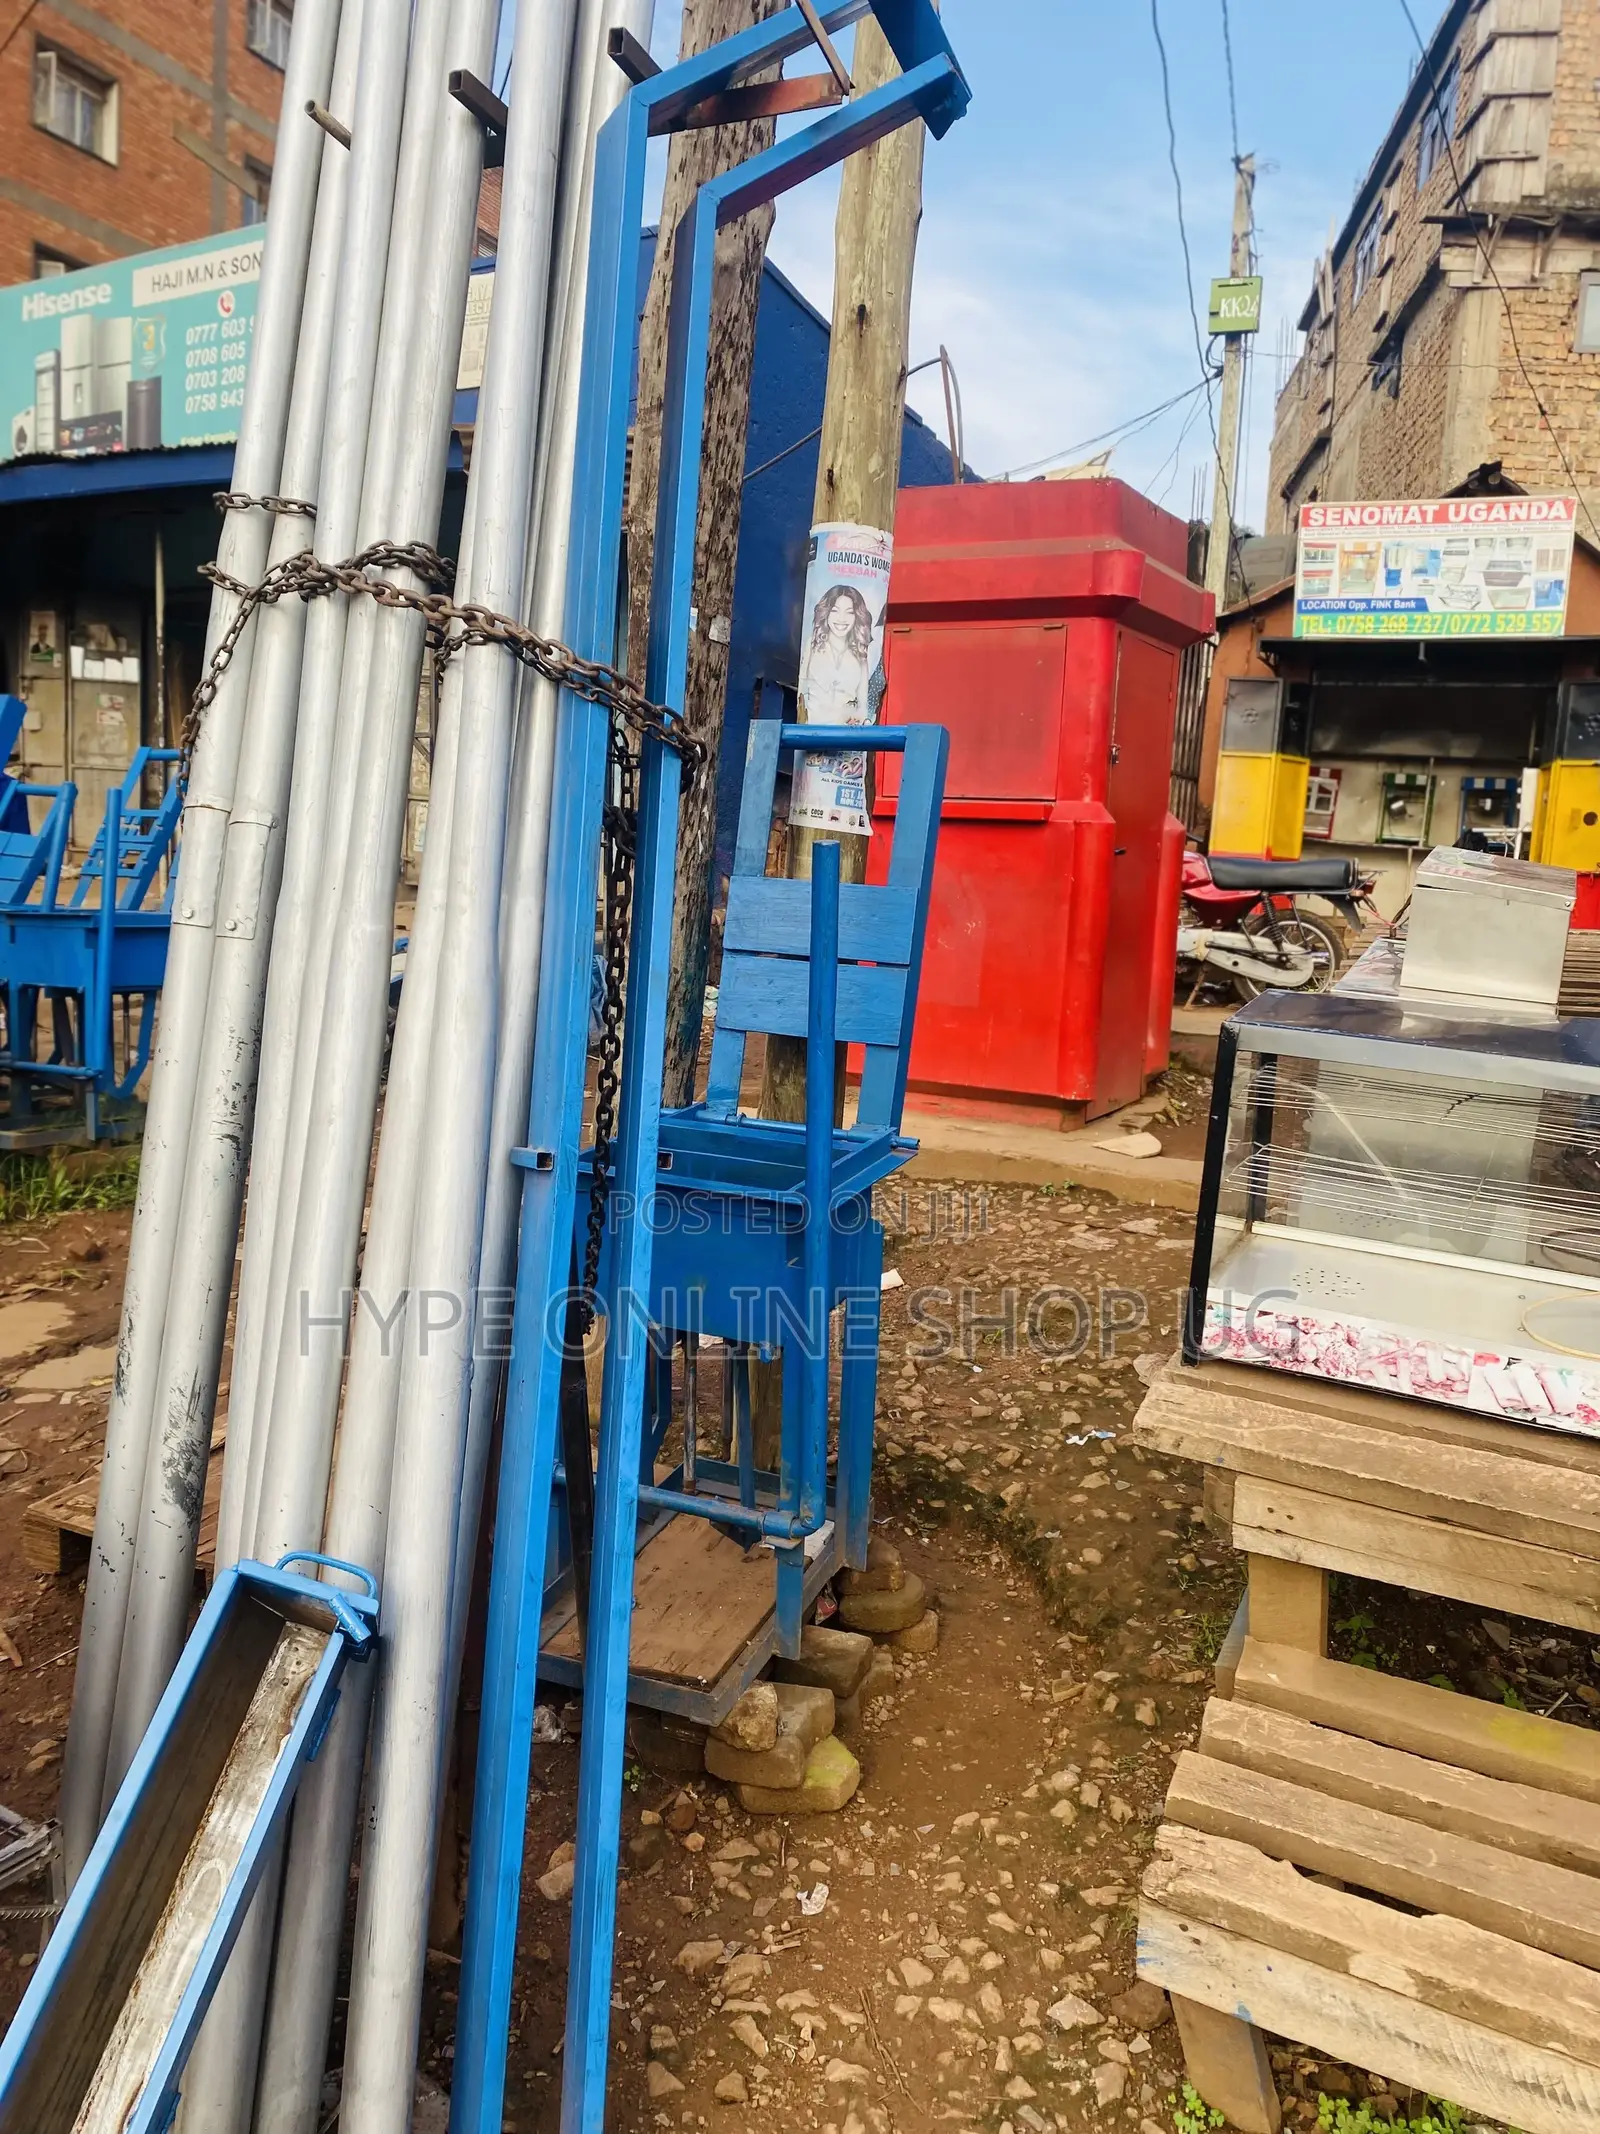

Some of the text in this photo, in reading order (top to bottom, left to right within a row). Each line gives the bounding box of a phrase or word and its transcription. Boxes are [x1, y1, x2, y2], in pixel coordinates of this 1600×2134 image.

[151, 270, 183, 293] HAJI
[187, 262, 214, 285] M.N
[218, 260, 227, 278] &
[22, 283, 112, 322] Hisense
[186, 323, 218, 345] 0777
[221, 317, 246, 338] 603
[185, 341, 246, 368] 0708 605
[185, 364, 246, 391] 0703 208
[185, 388, 244, 414] 0758 943
[1308, 500, 1568, 526] SENOMAT UGANDA
[828, 552, 870, 566] UGANDA'S
[1301, 599, 1416, 611] LOCATION Opp. FINK Bank
[1301, 615, 1332, 634] TEL:
[1336, 614, 1375, 634] 0758
[1495, 613, 1527, 632] 529
[1532, 612, 1564, 635] 557
